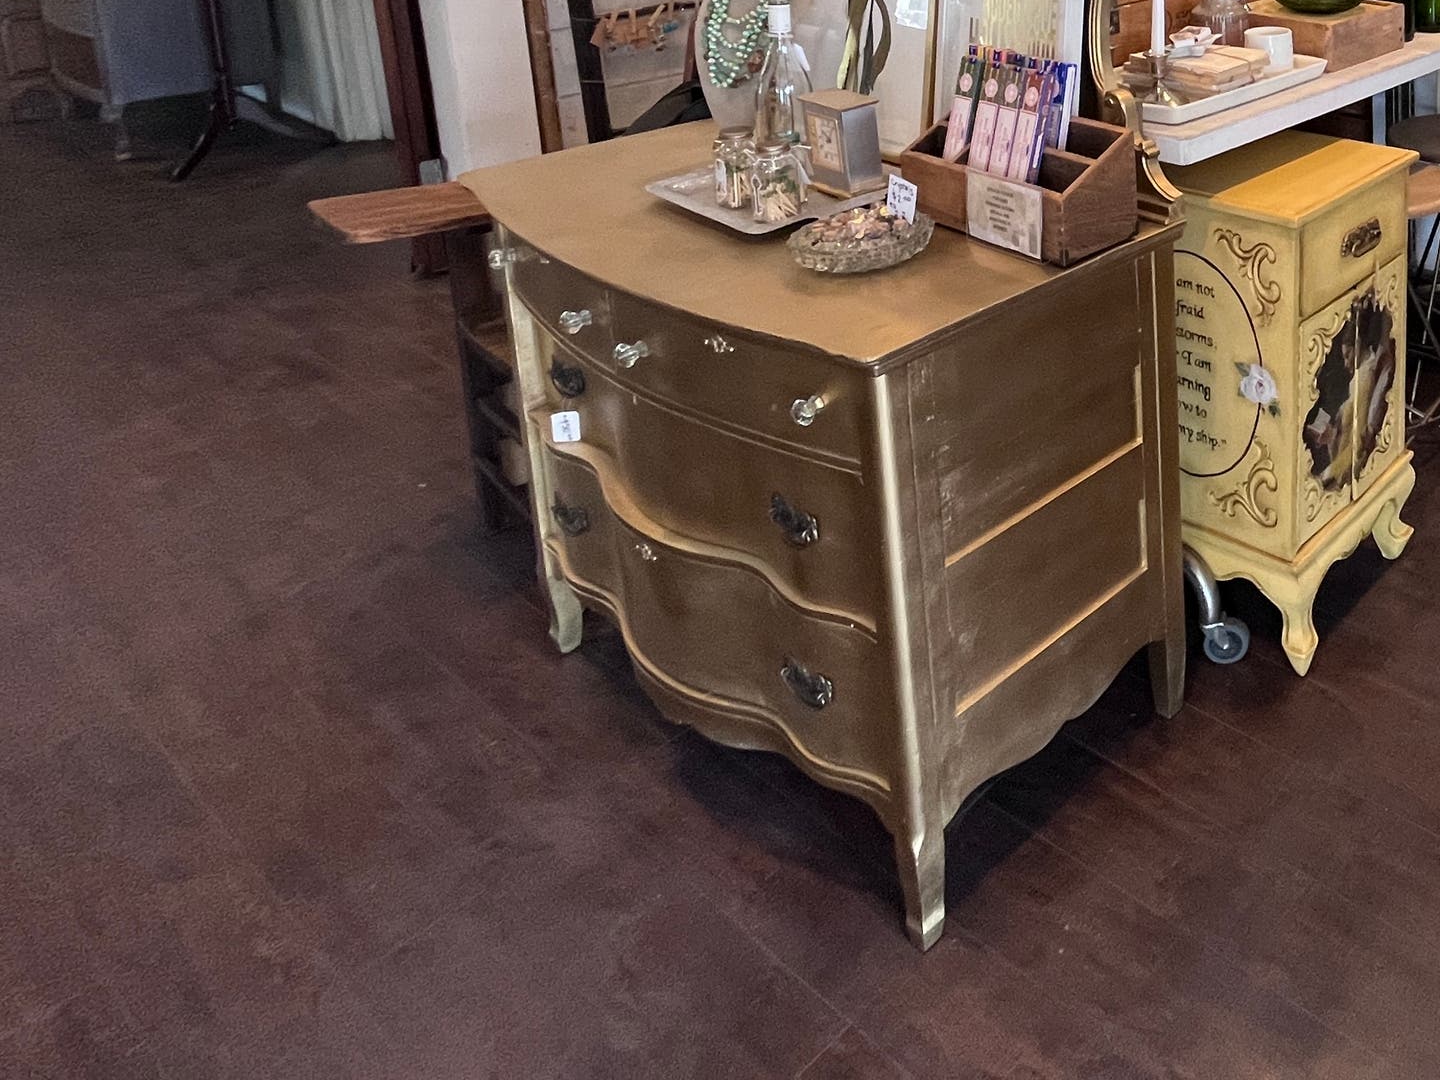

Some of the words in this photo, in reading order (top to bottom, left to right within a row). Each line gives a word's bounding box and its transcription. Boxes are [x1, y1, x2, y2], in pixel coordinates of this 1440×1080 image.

[1195, 284, 1215, 298] not
[1176, 300, 1205, 319] fraid
[1194, 358, 1212, 372] am
[1195, 405, 1208, 419] to
